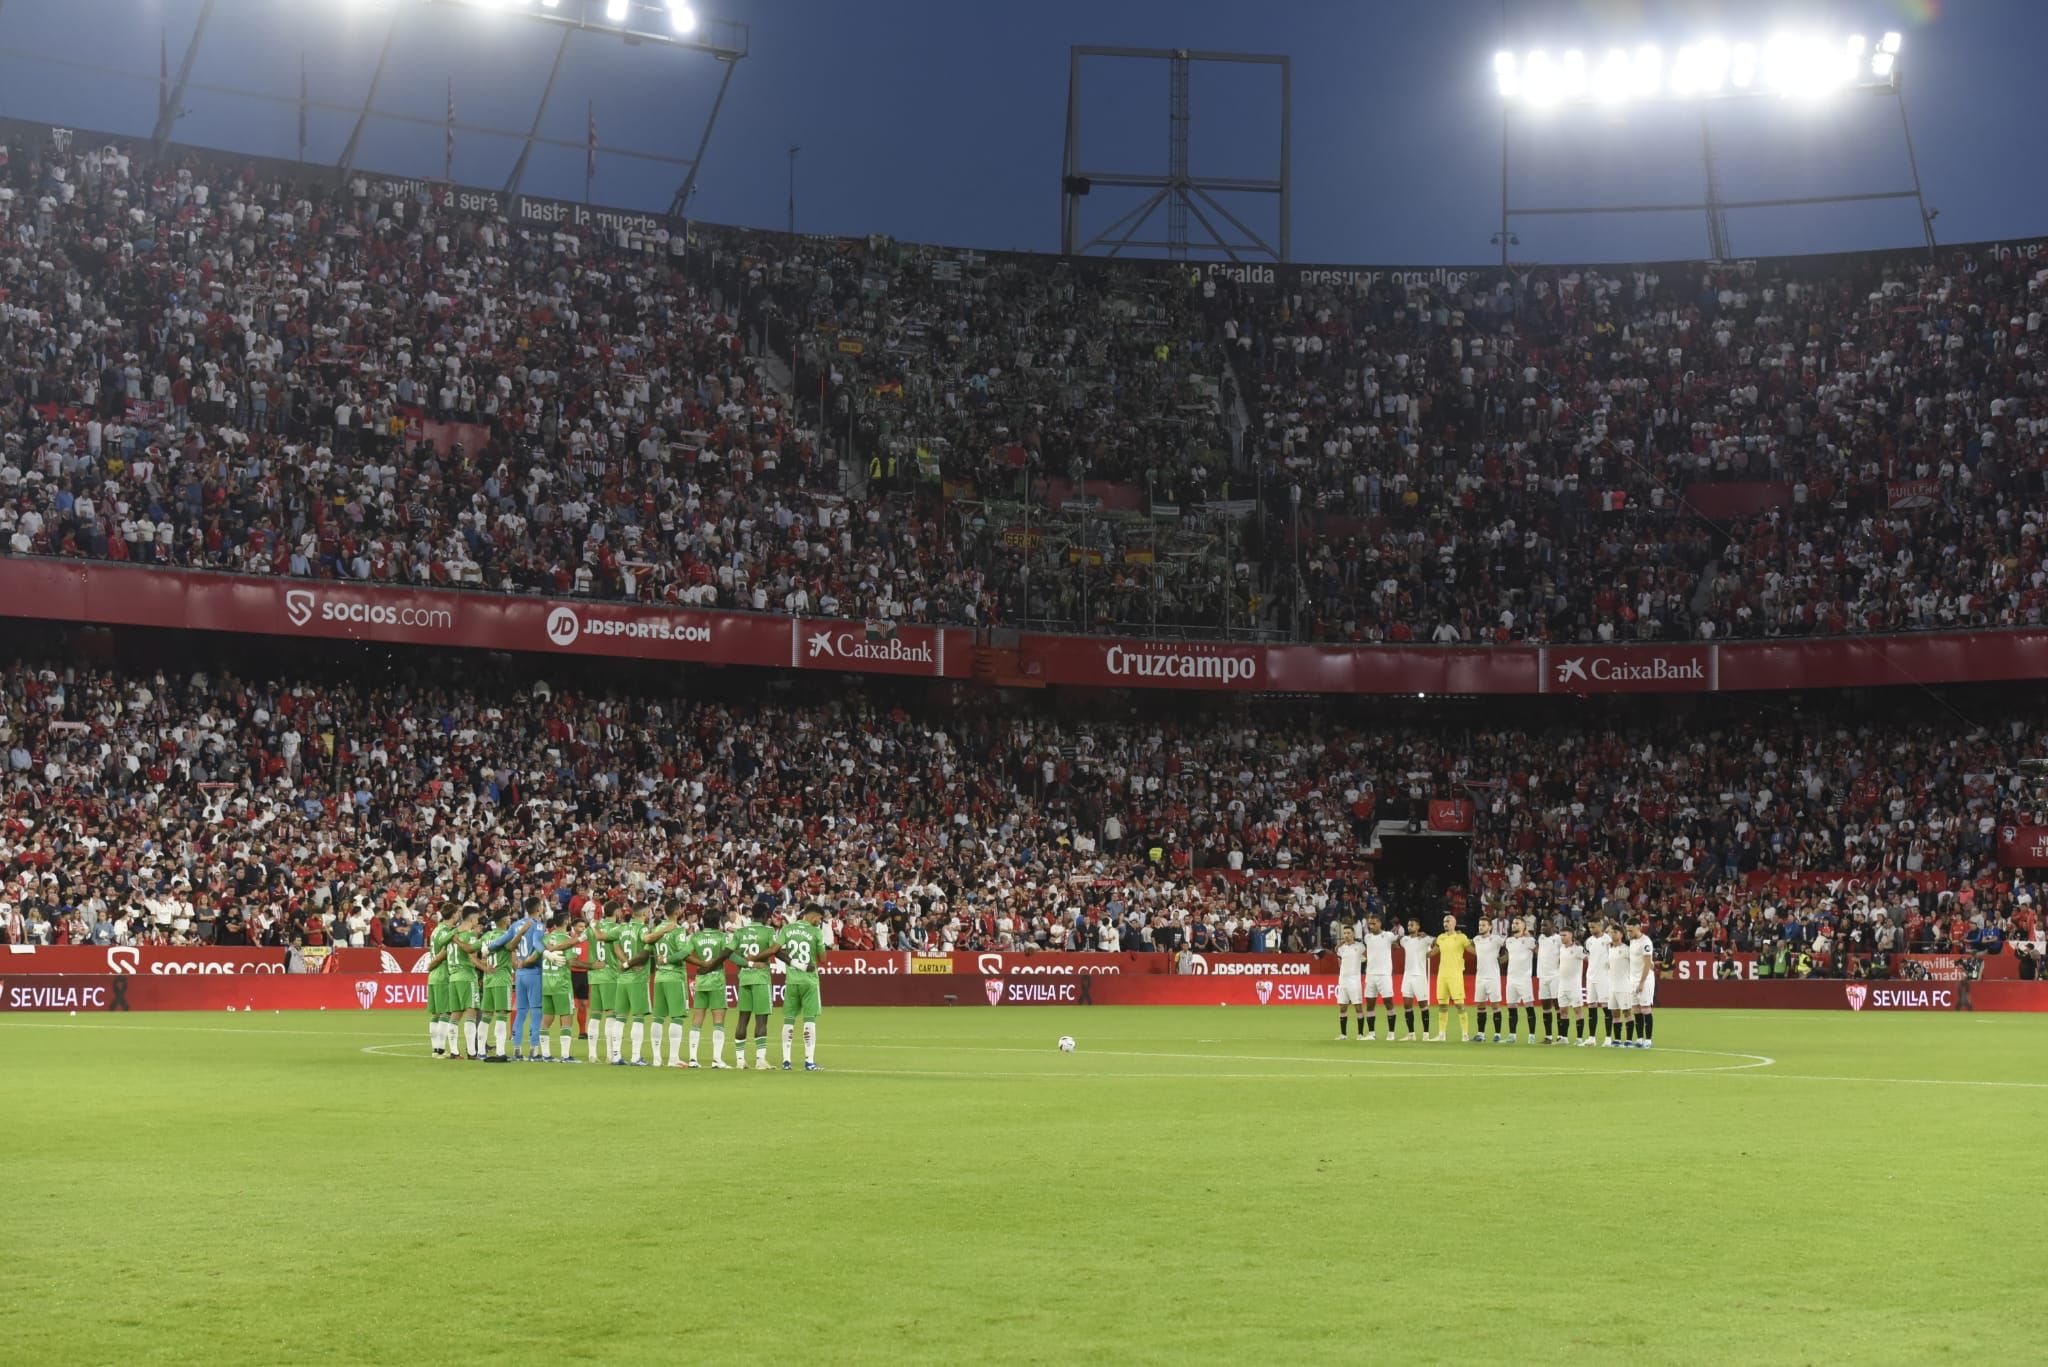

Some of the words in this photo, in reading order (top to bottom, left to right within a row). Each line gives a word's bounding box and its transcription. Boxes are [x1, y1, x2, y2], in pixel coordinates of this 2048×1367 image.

[521, 198, 569, 222] hasta
[575, 205, 591, 226] la
[1207, 263, 1275, 284] Giralda
[322, 601, 452, 629] SOCIOS.com
[583, 622, 711, 642] JDSPORTS.COM
[837, 634, 933, 663] CaixaBank
[1106, 644, 1256, 684] Cruzcampo
[1590, 657, 1705, 681] CaixaBank
[596, 940, 606, 962] 6
[623, 940, 633, 962] 5
[788, 939, 810, 964] 28
[151, 961, 286, 974] SOCIOScom
[817, 958, 899, 974] aixaBank
[1211, 963, 1310, 975] JDSPORTS.COM
[10, 987, 77, 1007] SEVILLA
[83, 986, 105, 1006] FC
[384, 985, 428, 1004] SEVIL
[1008, 984, 1055, 1001] SEVILLA
[1059, 984, 1075, 1001] FC
[1278, 984, 1324, 1000] SEVILLA
[1873, 990, 1929, 1006] SEVILLA
[1932, 990, 1951, 1006] FC
